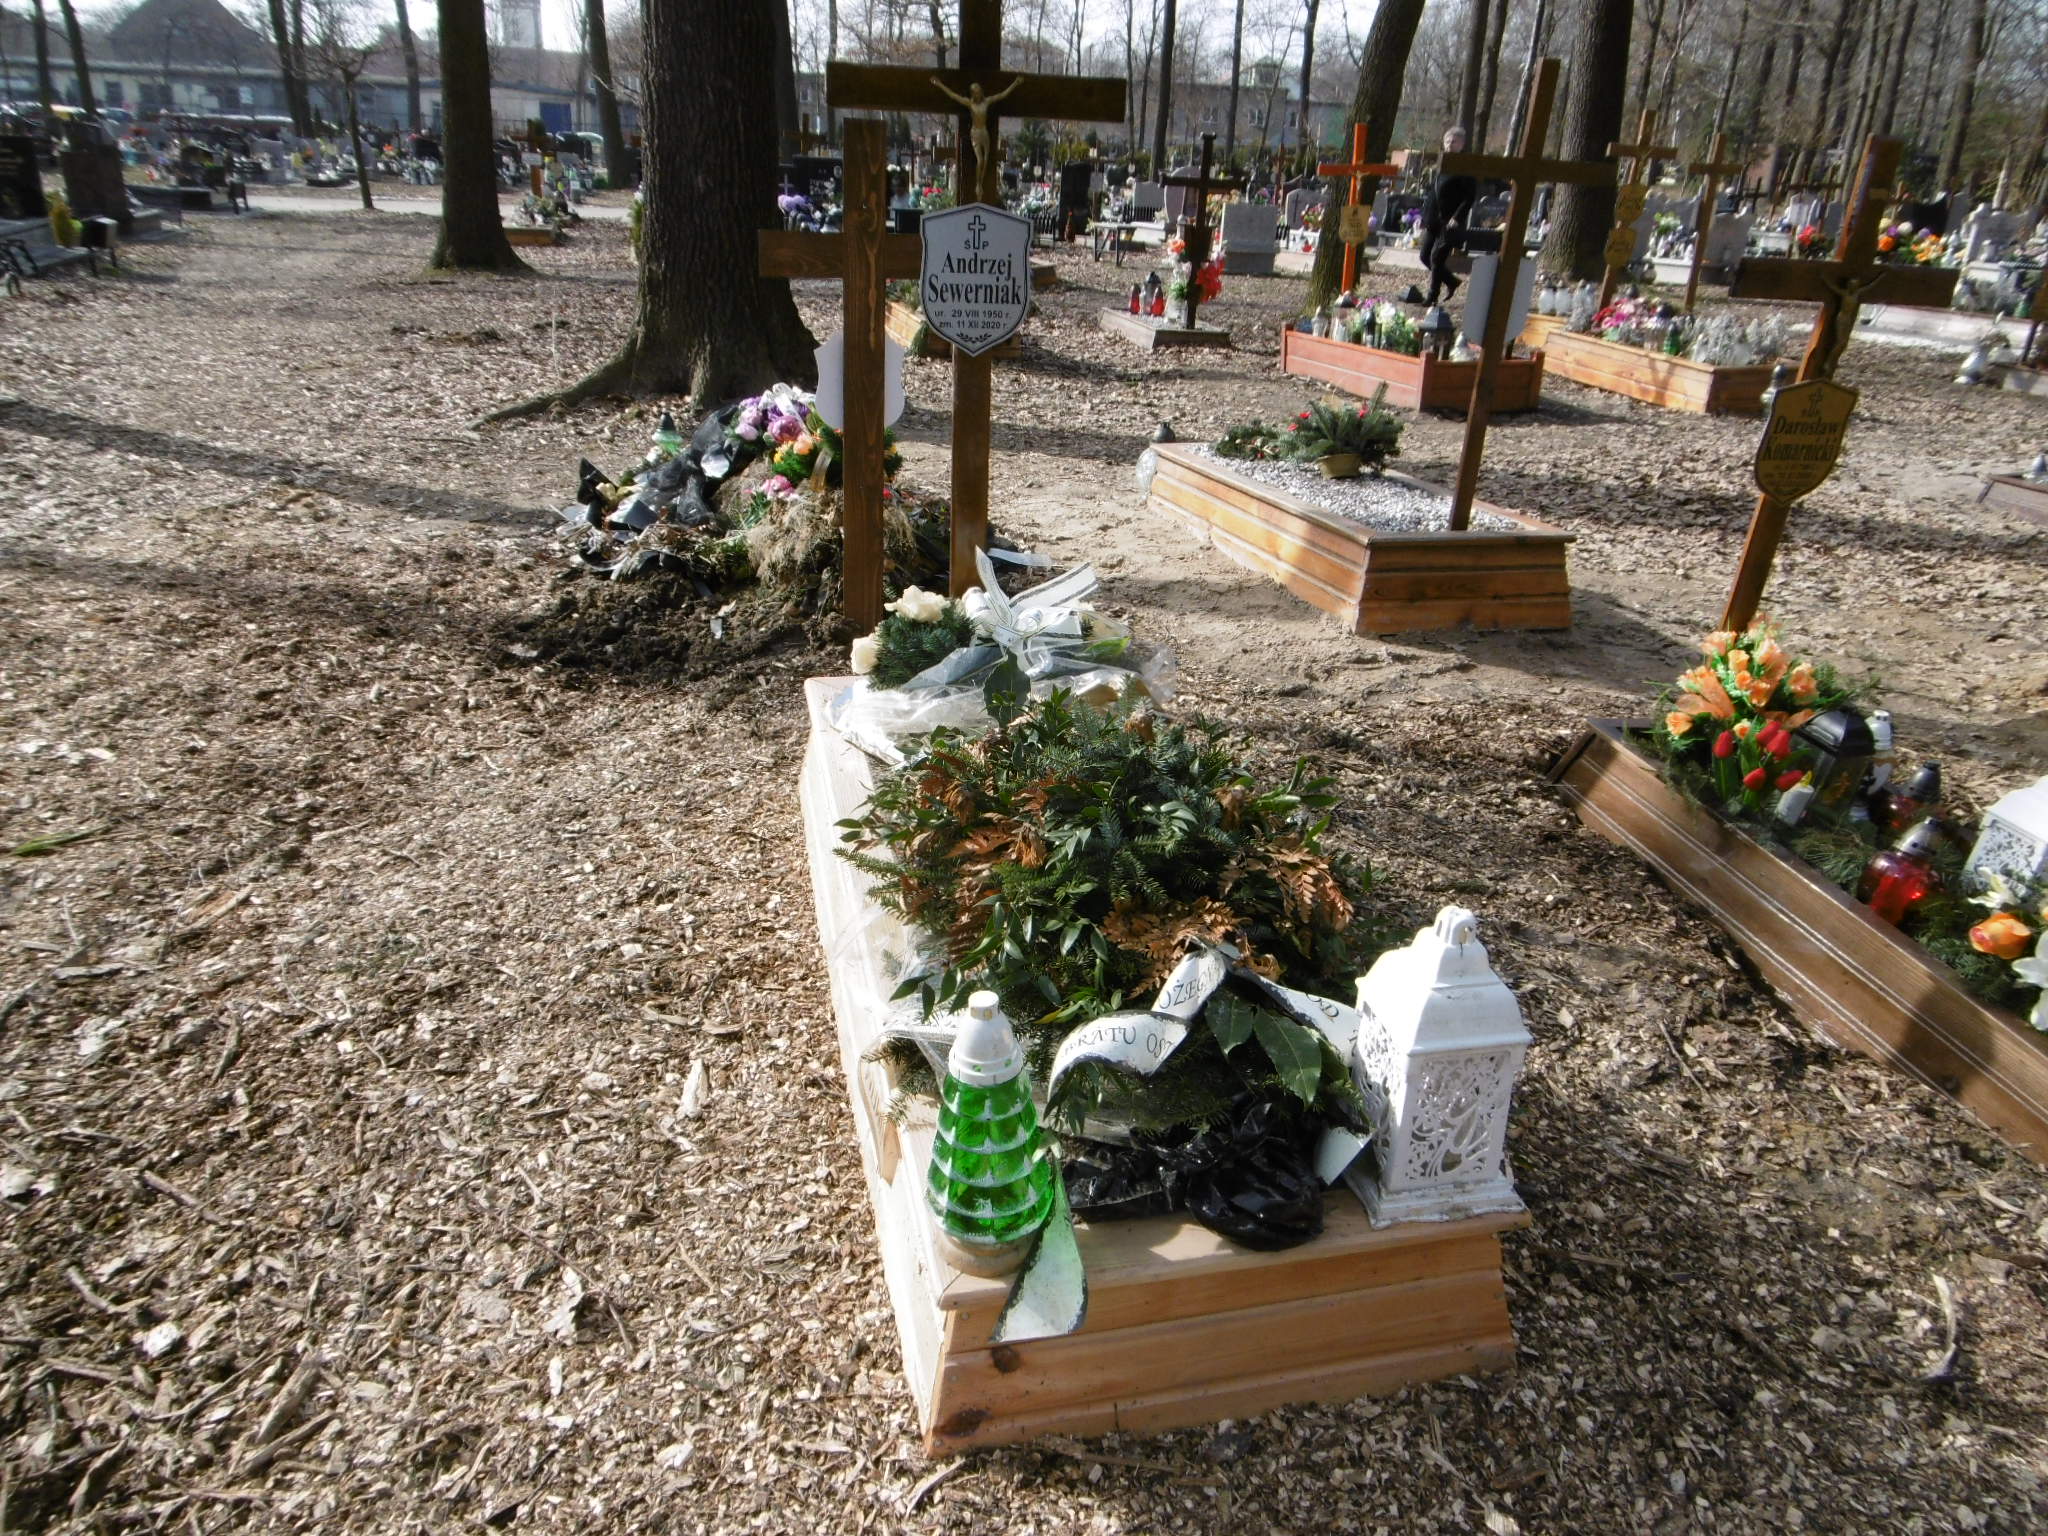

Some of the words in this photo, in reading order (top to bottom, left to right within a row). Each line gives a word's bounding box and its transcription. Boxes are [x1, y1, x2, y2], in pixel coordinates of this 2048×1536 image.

[941, 251, 1012, 281] Andrzej
[928, 273, 1022, 305] Sewerniak
[951, 309, 963, 318] 29
[982, 310, 1003, 319] 1950
[956, 320, 965, 329] 11
[981, 321, 1001, 329] 2020
